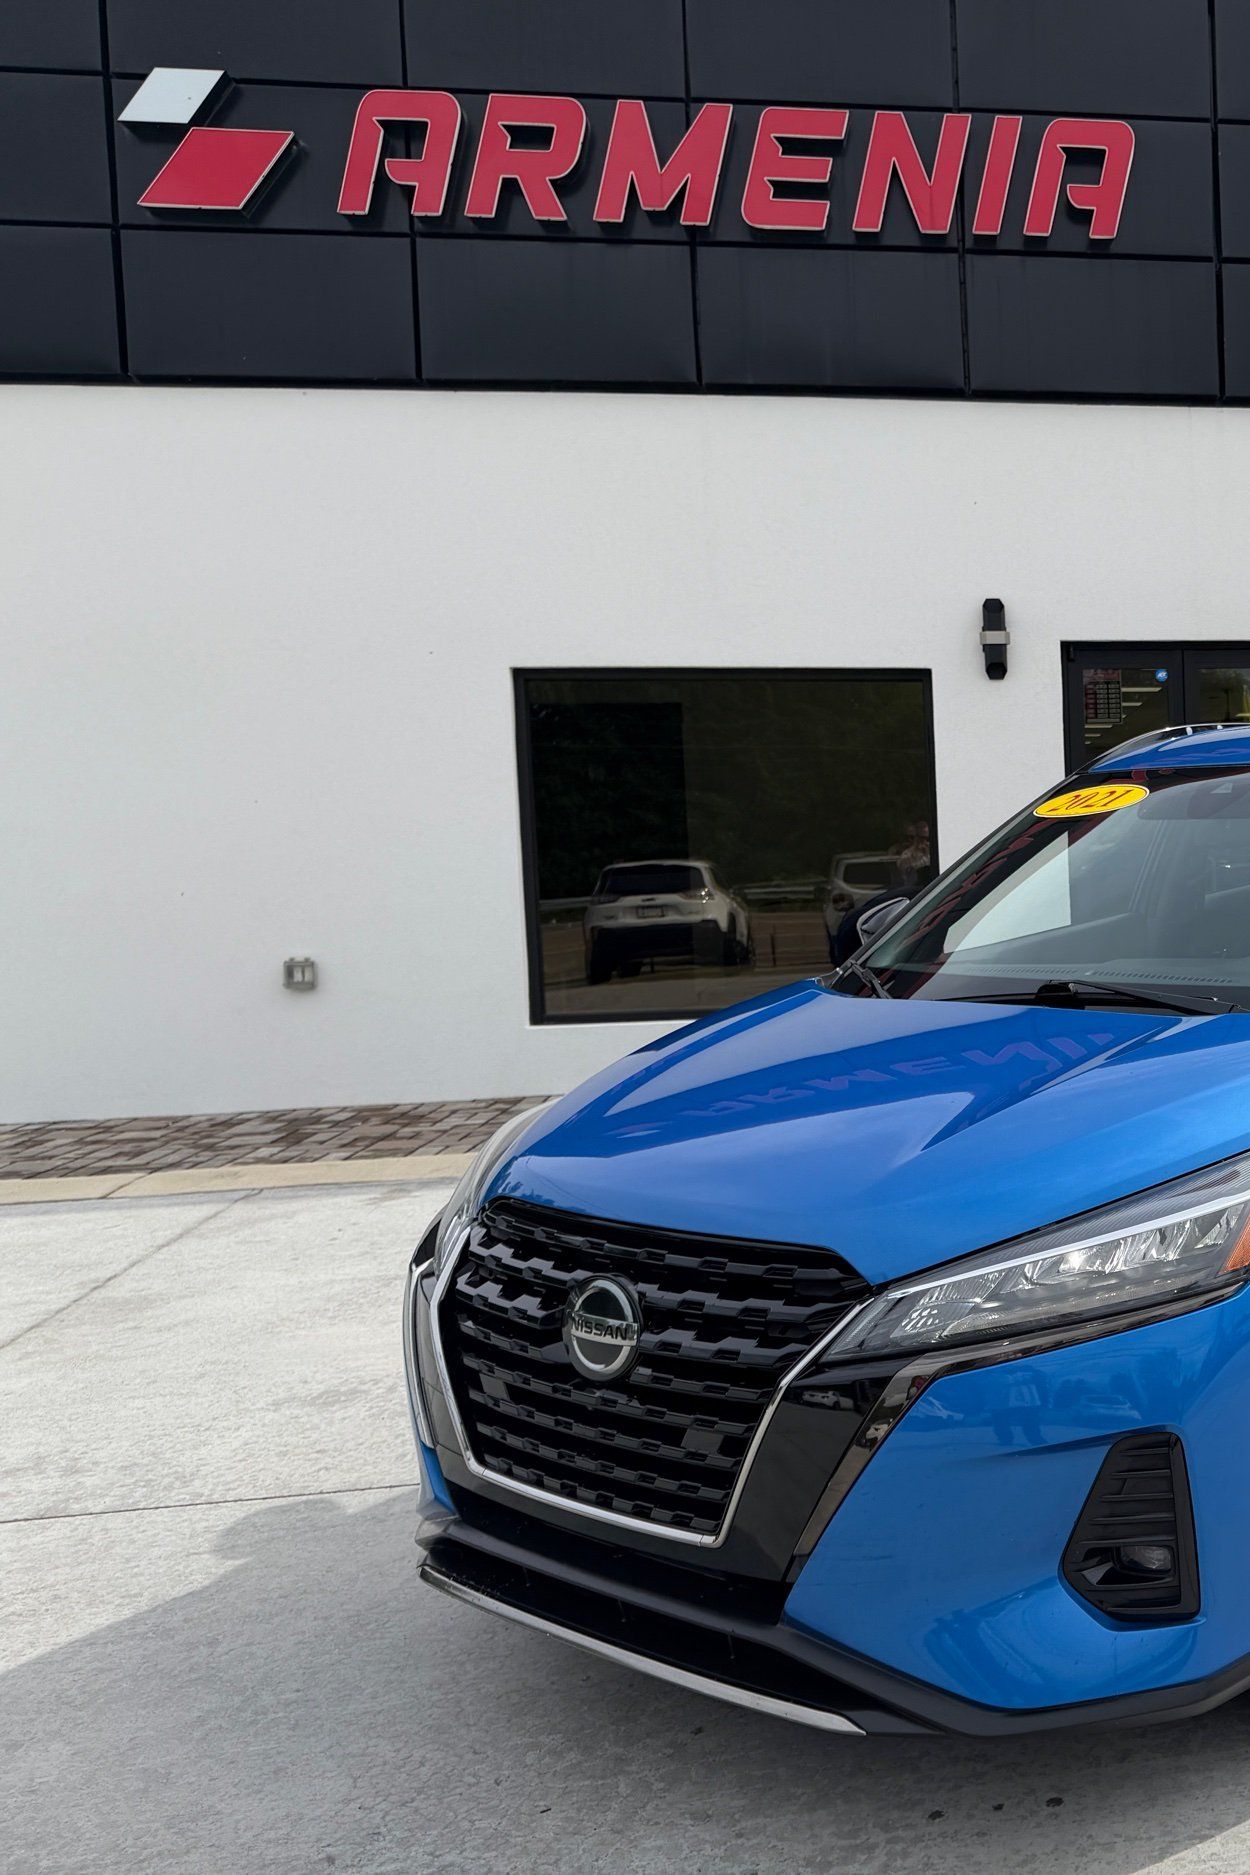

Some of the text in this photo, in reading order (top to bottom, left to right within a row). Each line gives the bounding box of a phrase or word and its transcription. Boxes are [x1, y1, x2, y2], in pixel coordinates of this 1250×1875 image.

[336, 88, 1136, 240] ARMENIA
[1046, 788, 1134, 813] 2021
[572, 1317, 628, 1341] NISSAN
